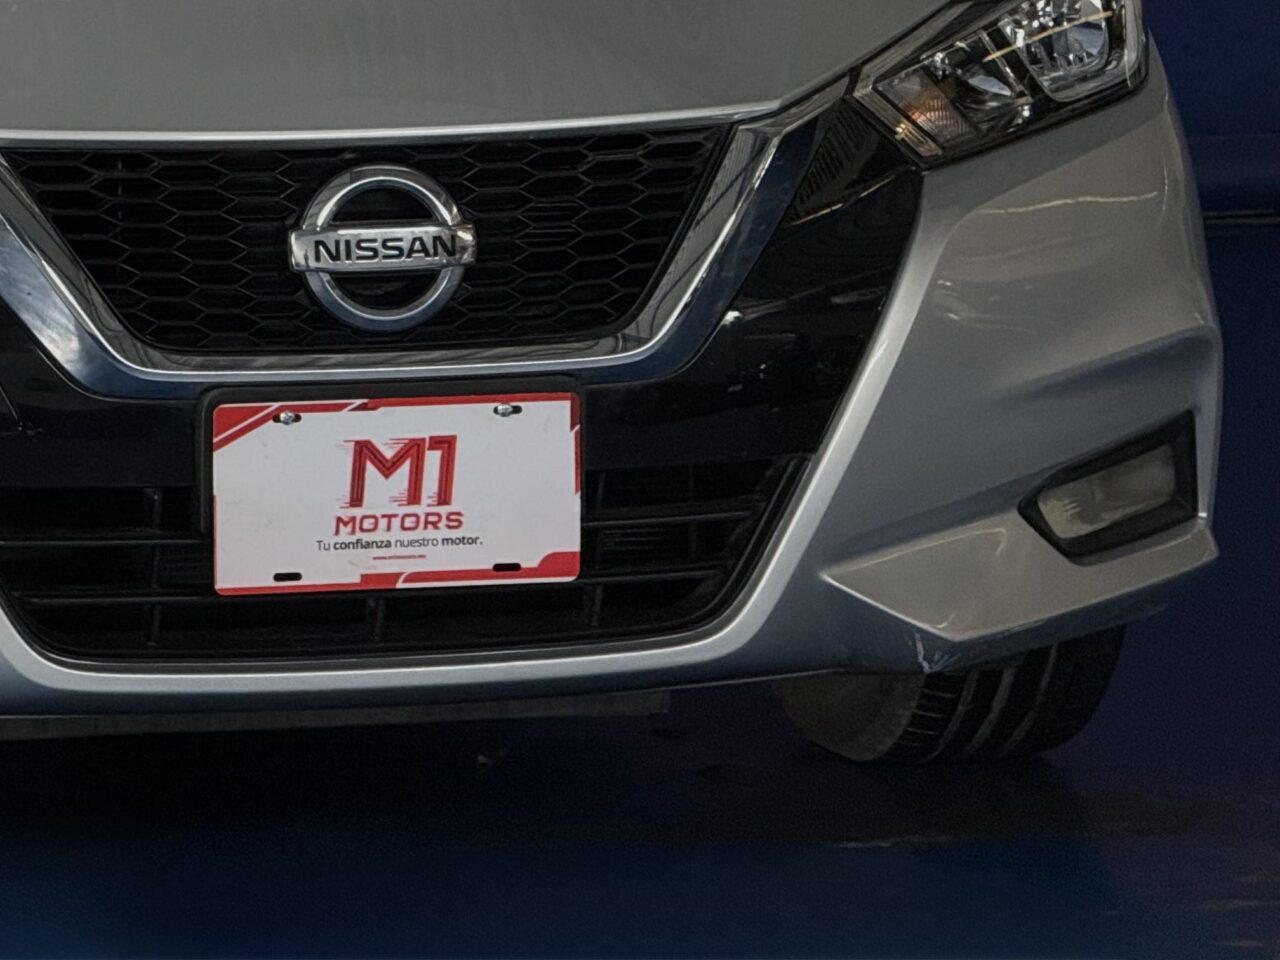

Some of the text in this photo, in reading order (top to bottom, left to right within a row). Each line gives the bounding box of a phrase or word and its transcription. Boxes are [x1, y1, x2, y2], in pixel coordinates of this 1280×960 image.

[314, 234, 457, 263] NISSAN
[340, 434, 458, 509] M1
[333, 511, 464, 537] MOTORS
[316, 534, 484, 552] Tu confianza nuestro motor.
